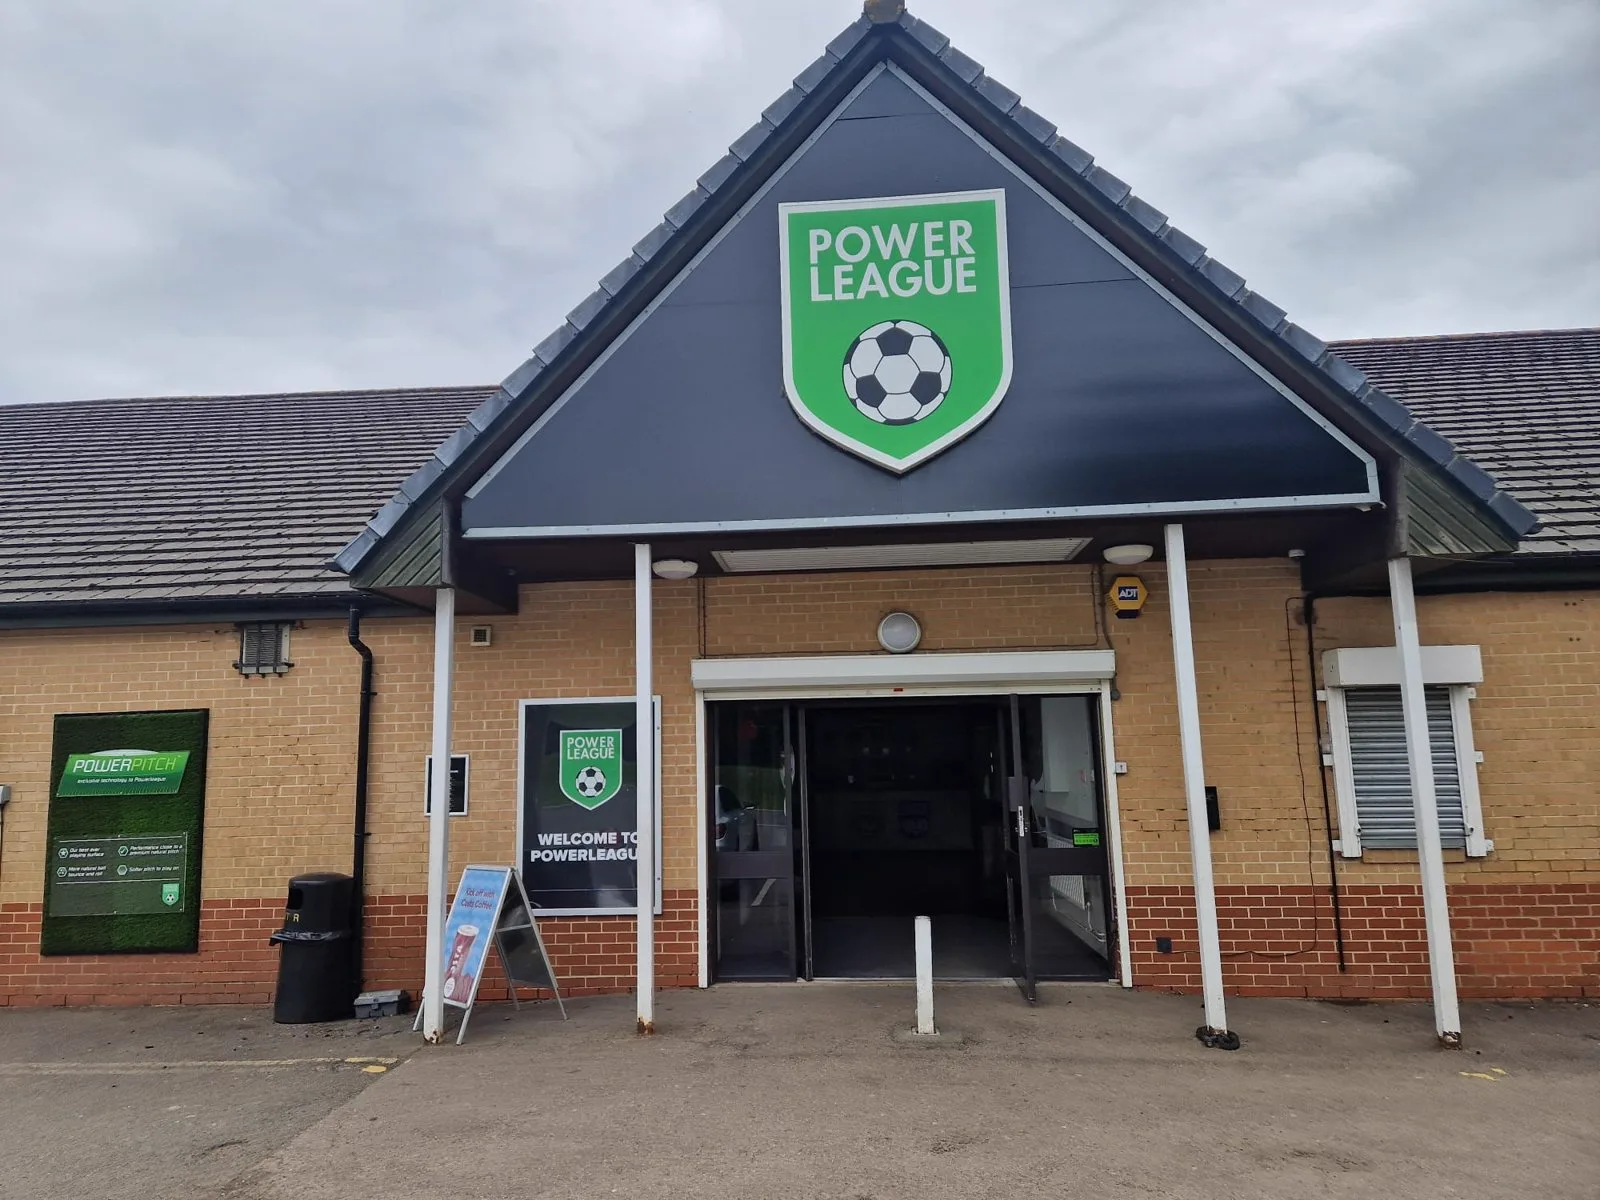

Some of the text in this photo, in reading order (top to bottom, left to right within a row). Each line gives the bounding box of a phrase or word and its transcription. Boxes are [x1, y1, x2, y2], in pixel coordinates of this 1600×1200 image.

[809, 219, 976, 264] POWER
[810, 257, 977, 302] LEAGUE
[1118, 588, 1138, 598] ADT
[567, 736, 615, 749] POWER
[567, 747, 615, 760] LEAGUE
[73, 757, 176, 773] POWERPITCH
[537, 832, 638, 846] WELCOME TO
[531, 848, 638, 862] POWERLEAGU
